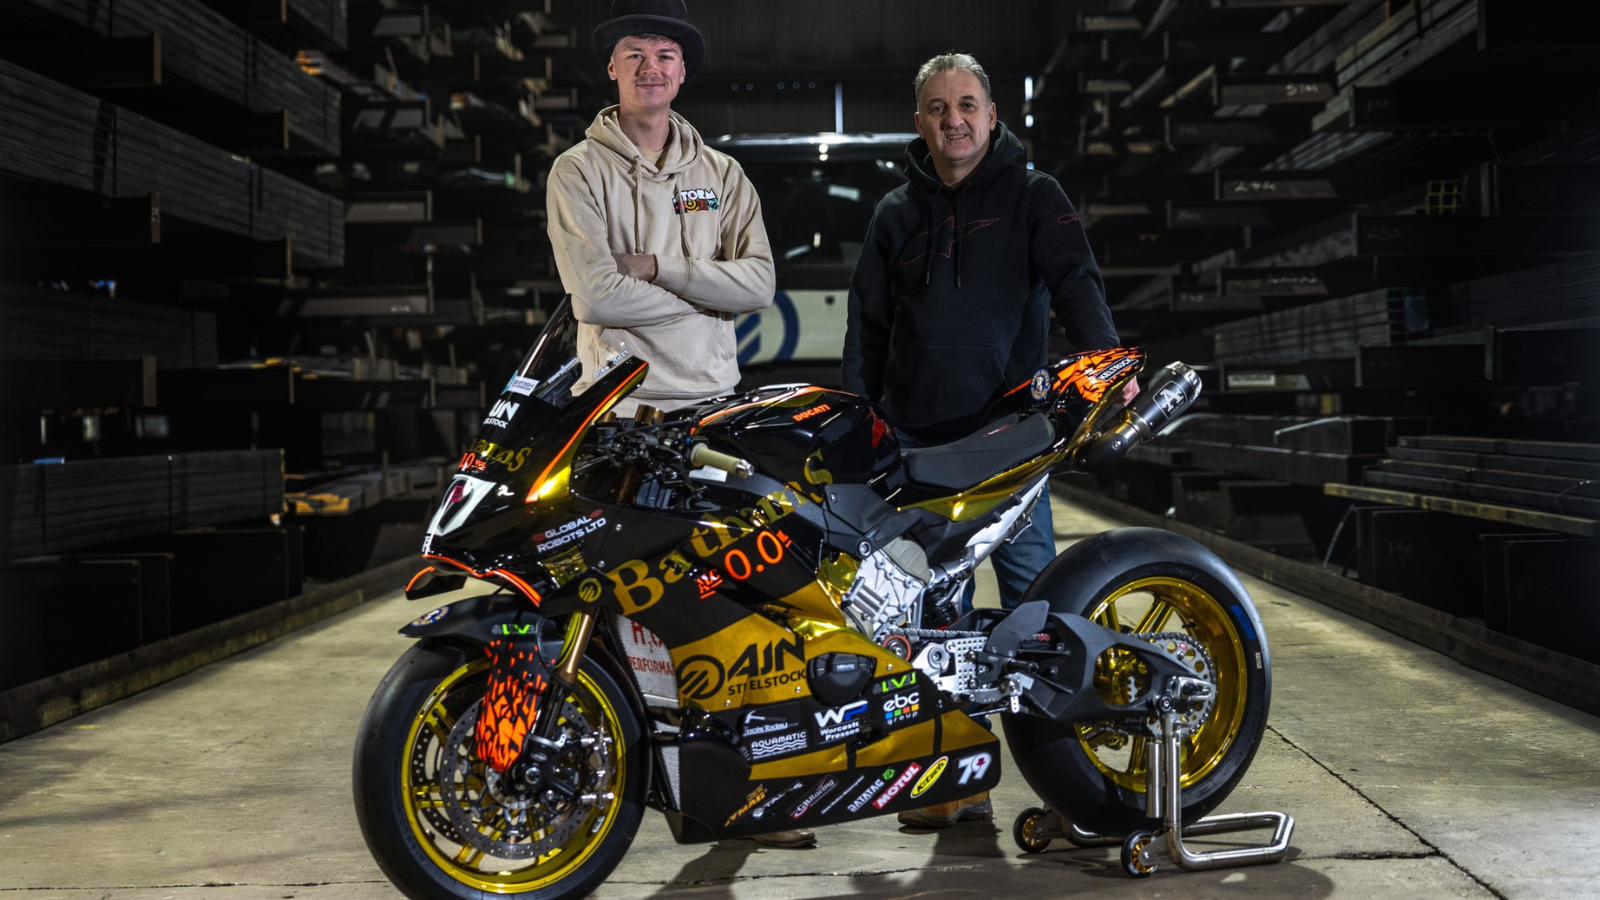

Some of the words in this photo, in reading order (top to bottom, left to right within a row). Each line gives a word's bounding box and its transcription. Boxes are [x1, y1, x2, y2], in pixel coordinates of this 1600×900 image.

[672, 188, 717, 203] TORM
[1098, 357, 1134, 381] KELTRUCK
[792, 402, 832, 423] DUCATI
[536, 528, 585, 552] ROBOTS
[585, 517, 607, 534] LTD
[544, 516, 592, 538] GLOBAL
[724, 530, 783, 580] 0.0
[727, 632, 806, 682] AJN
[813, 700, 869, 728] WP
[882, 691, 920, 712] ebc
[886, 711, 919, 726] group
[751, 731, 807, 749] AQUAMATIC
[957, 752, 992, 785] 79
[796, 779, 836, 813] GBRacing
[847, 778, 885, 813] DATATAG
[876, 765, 921, 808] MOTUL
